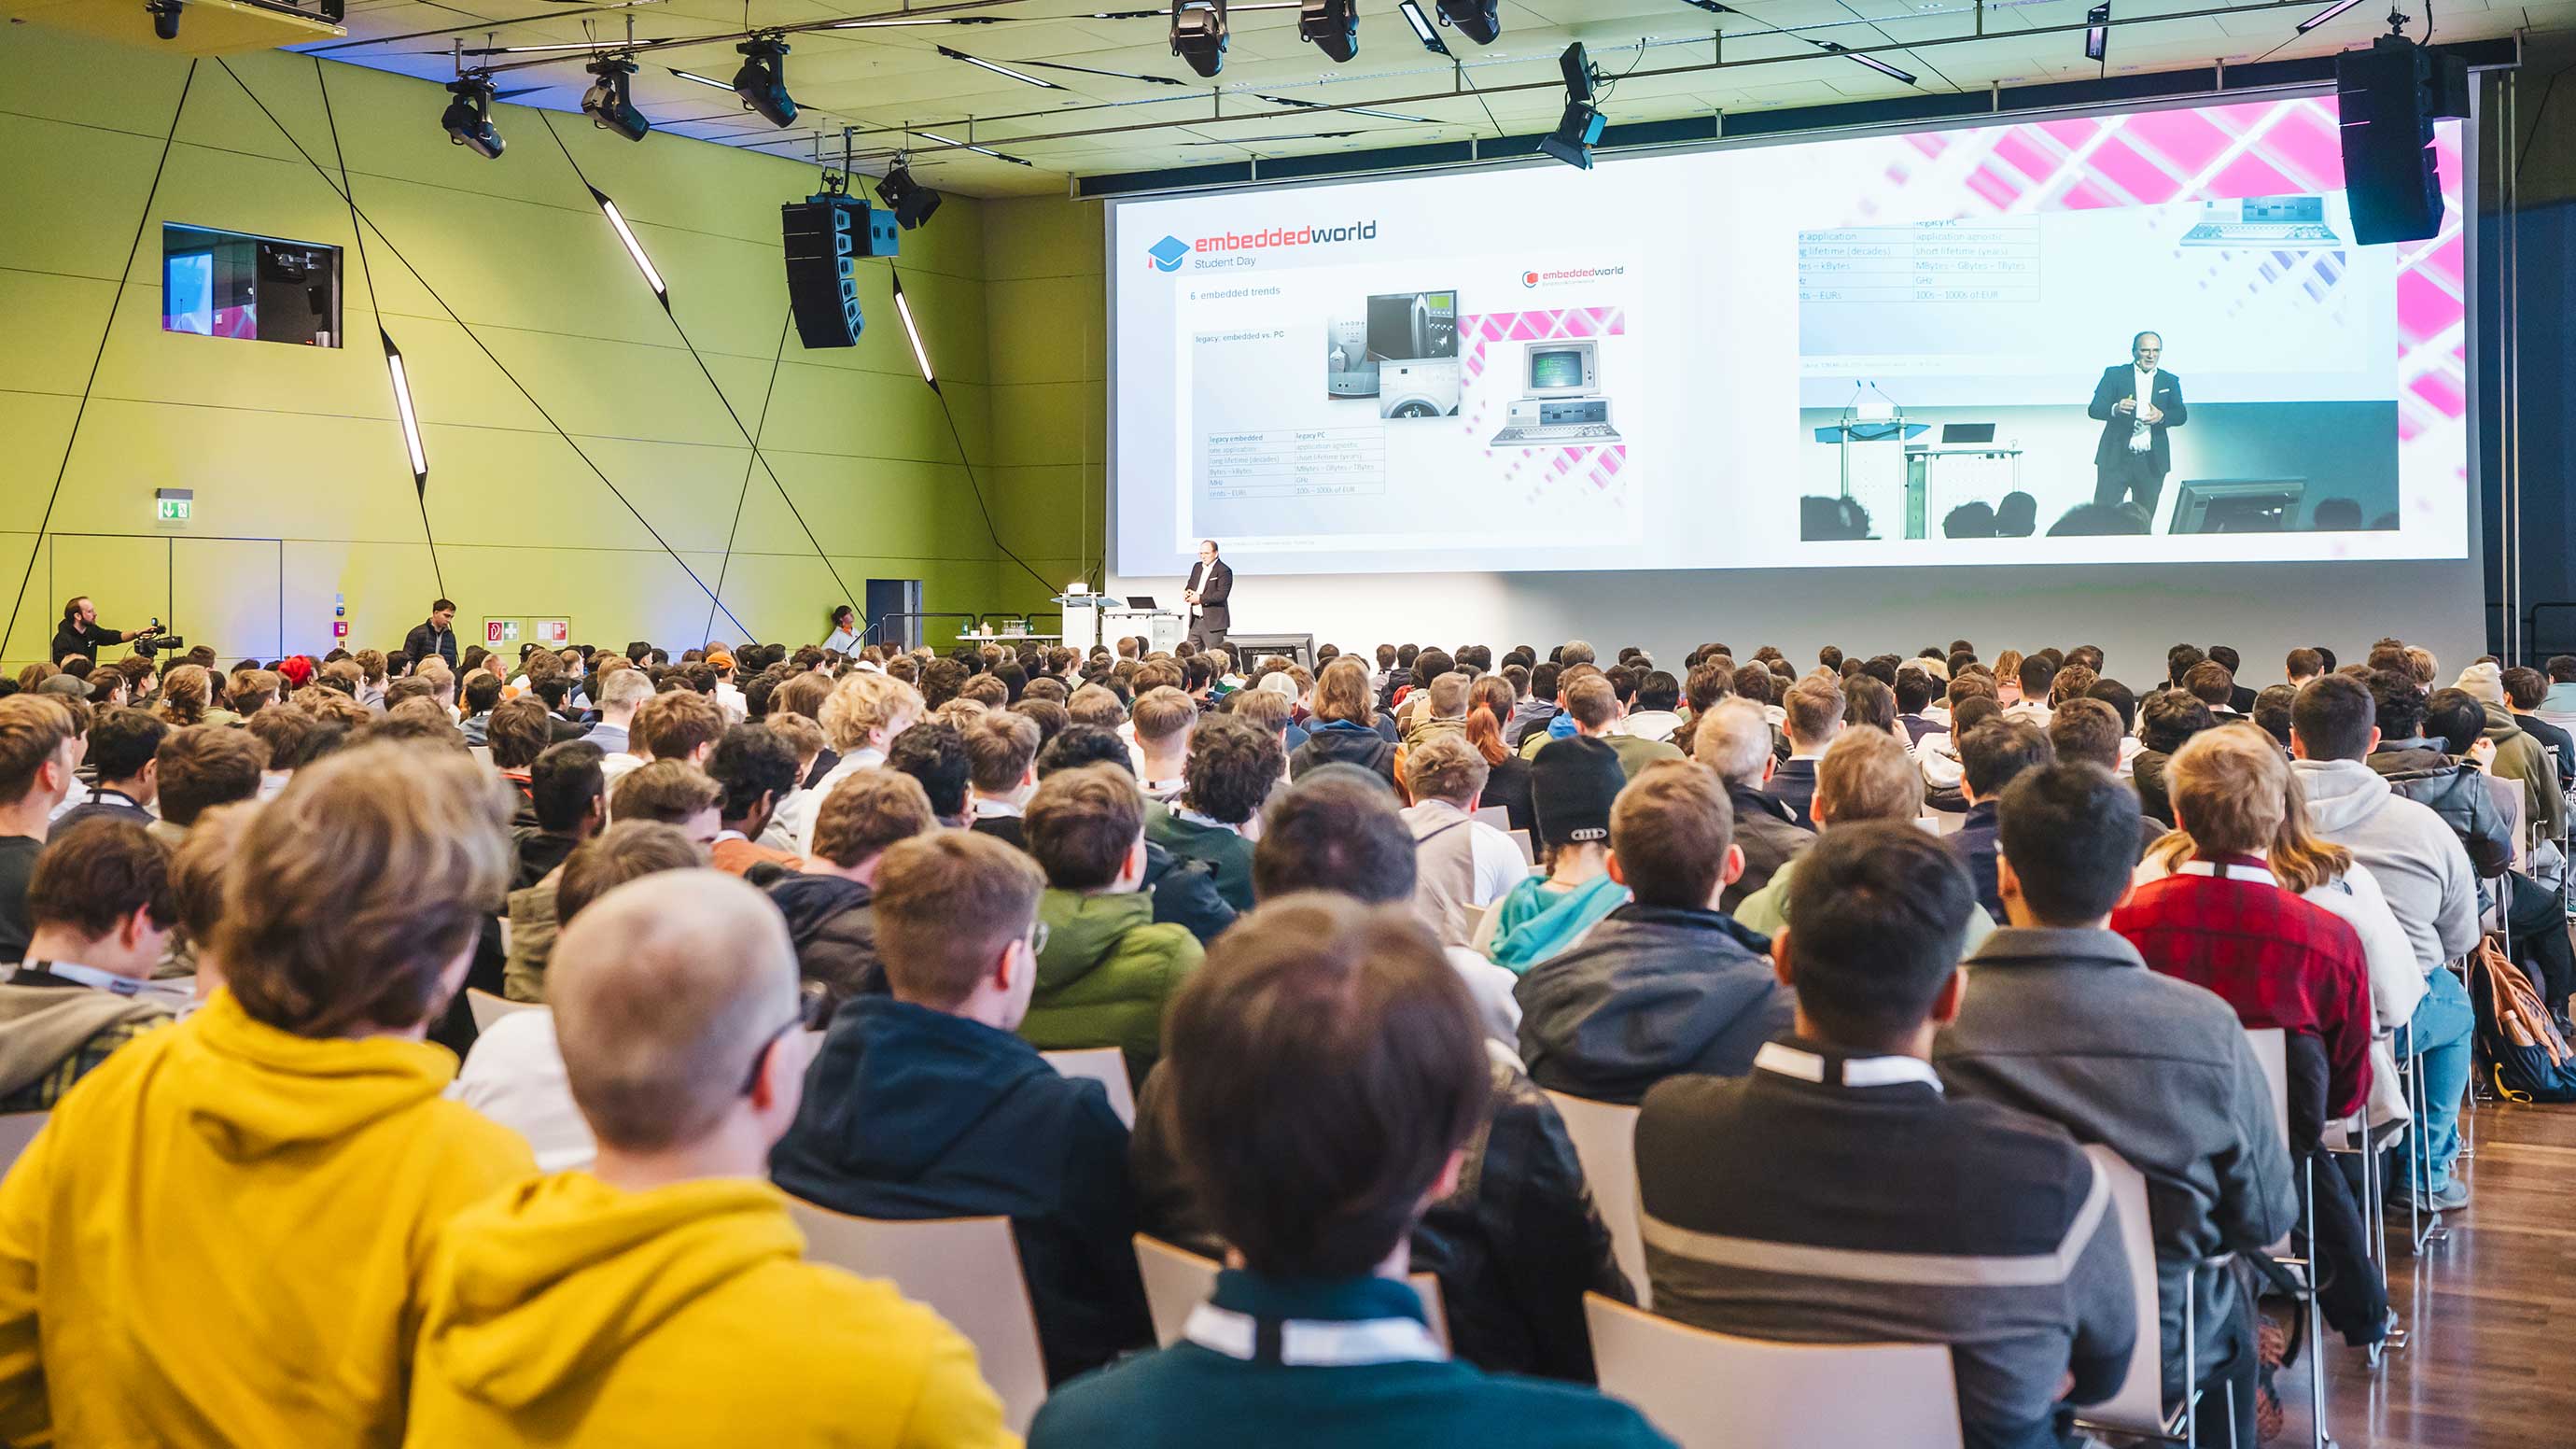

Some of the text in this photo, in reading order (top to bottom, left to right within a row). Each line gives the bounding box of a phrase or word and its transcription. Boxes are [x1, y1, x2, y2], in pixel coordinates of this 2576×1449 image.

[1195, 219, 1377, 253] embeddedworld
[1806, 232, 1857, 242] application
[1916, 232, 1965, 242] application
[1809, 246, 1845, 255] lifetime
[1847, 246, 1891, 257] (decades)
[1915, 246, 1939, 255] short
[1939, 246, 1975, 255] lifetime
[1195, 255, 1257, 270] Student Day
[1915, 261, 1949, 271] MBytes
[1957, 261, 1987, 271] GBytes
[1543, 266, 1624, 279] embeddedworld
[1200, 288, 1249, 301] embedded
[1251, 286, 1281, 297] trends
[1981, 290, 1998, 299] EUR
[1223, 331, 1260, 342] embedded
[1274, 331, 1285, 339] PC
[1210, 434, 1264, 444] legacy embedded
[1296, 431, 1317, 441] legacy
